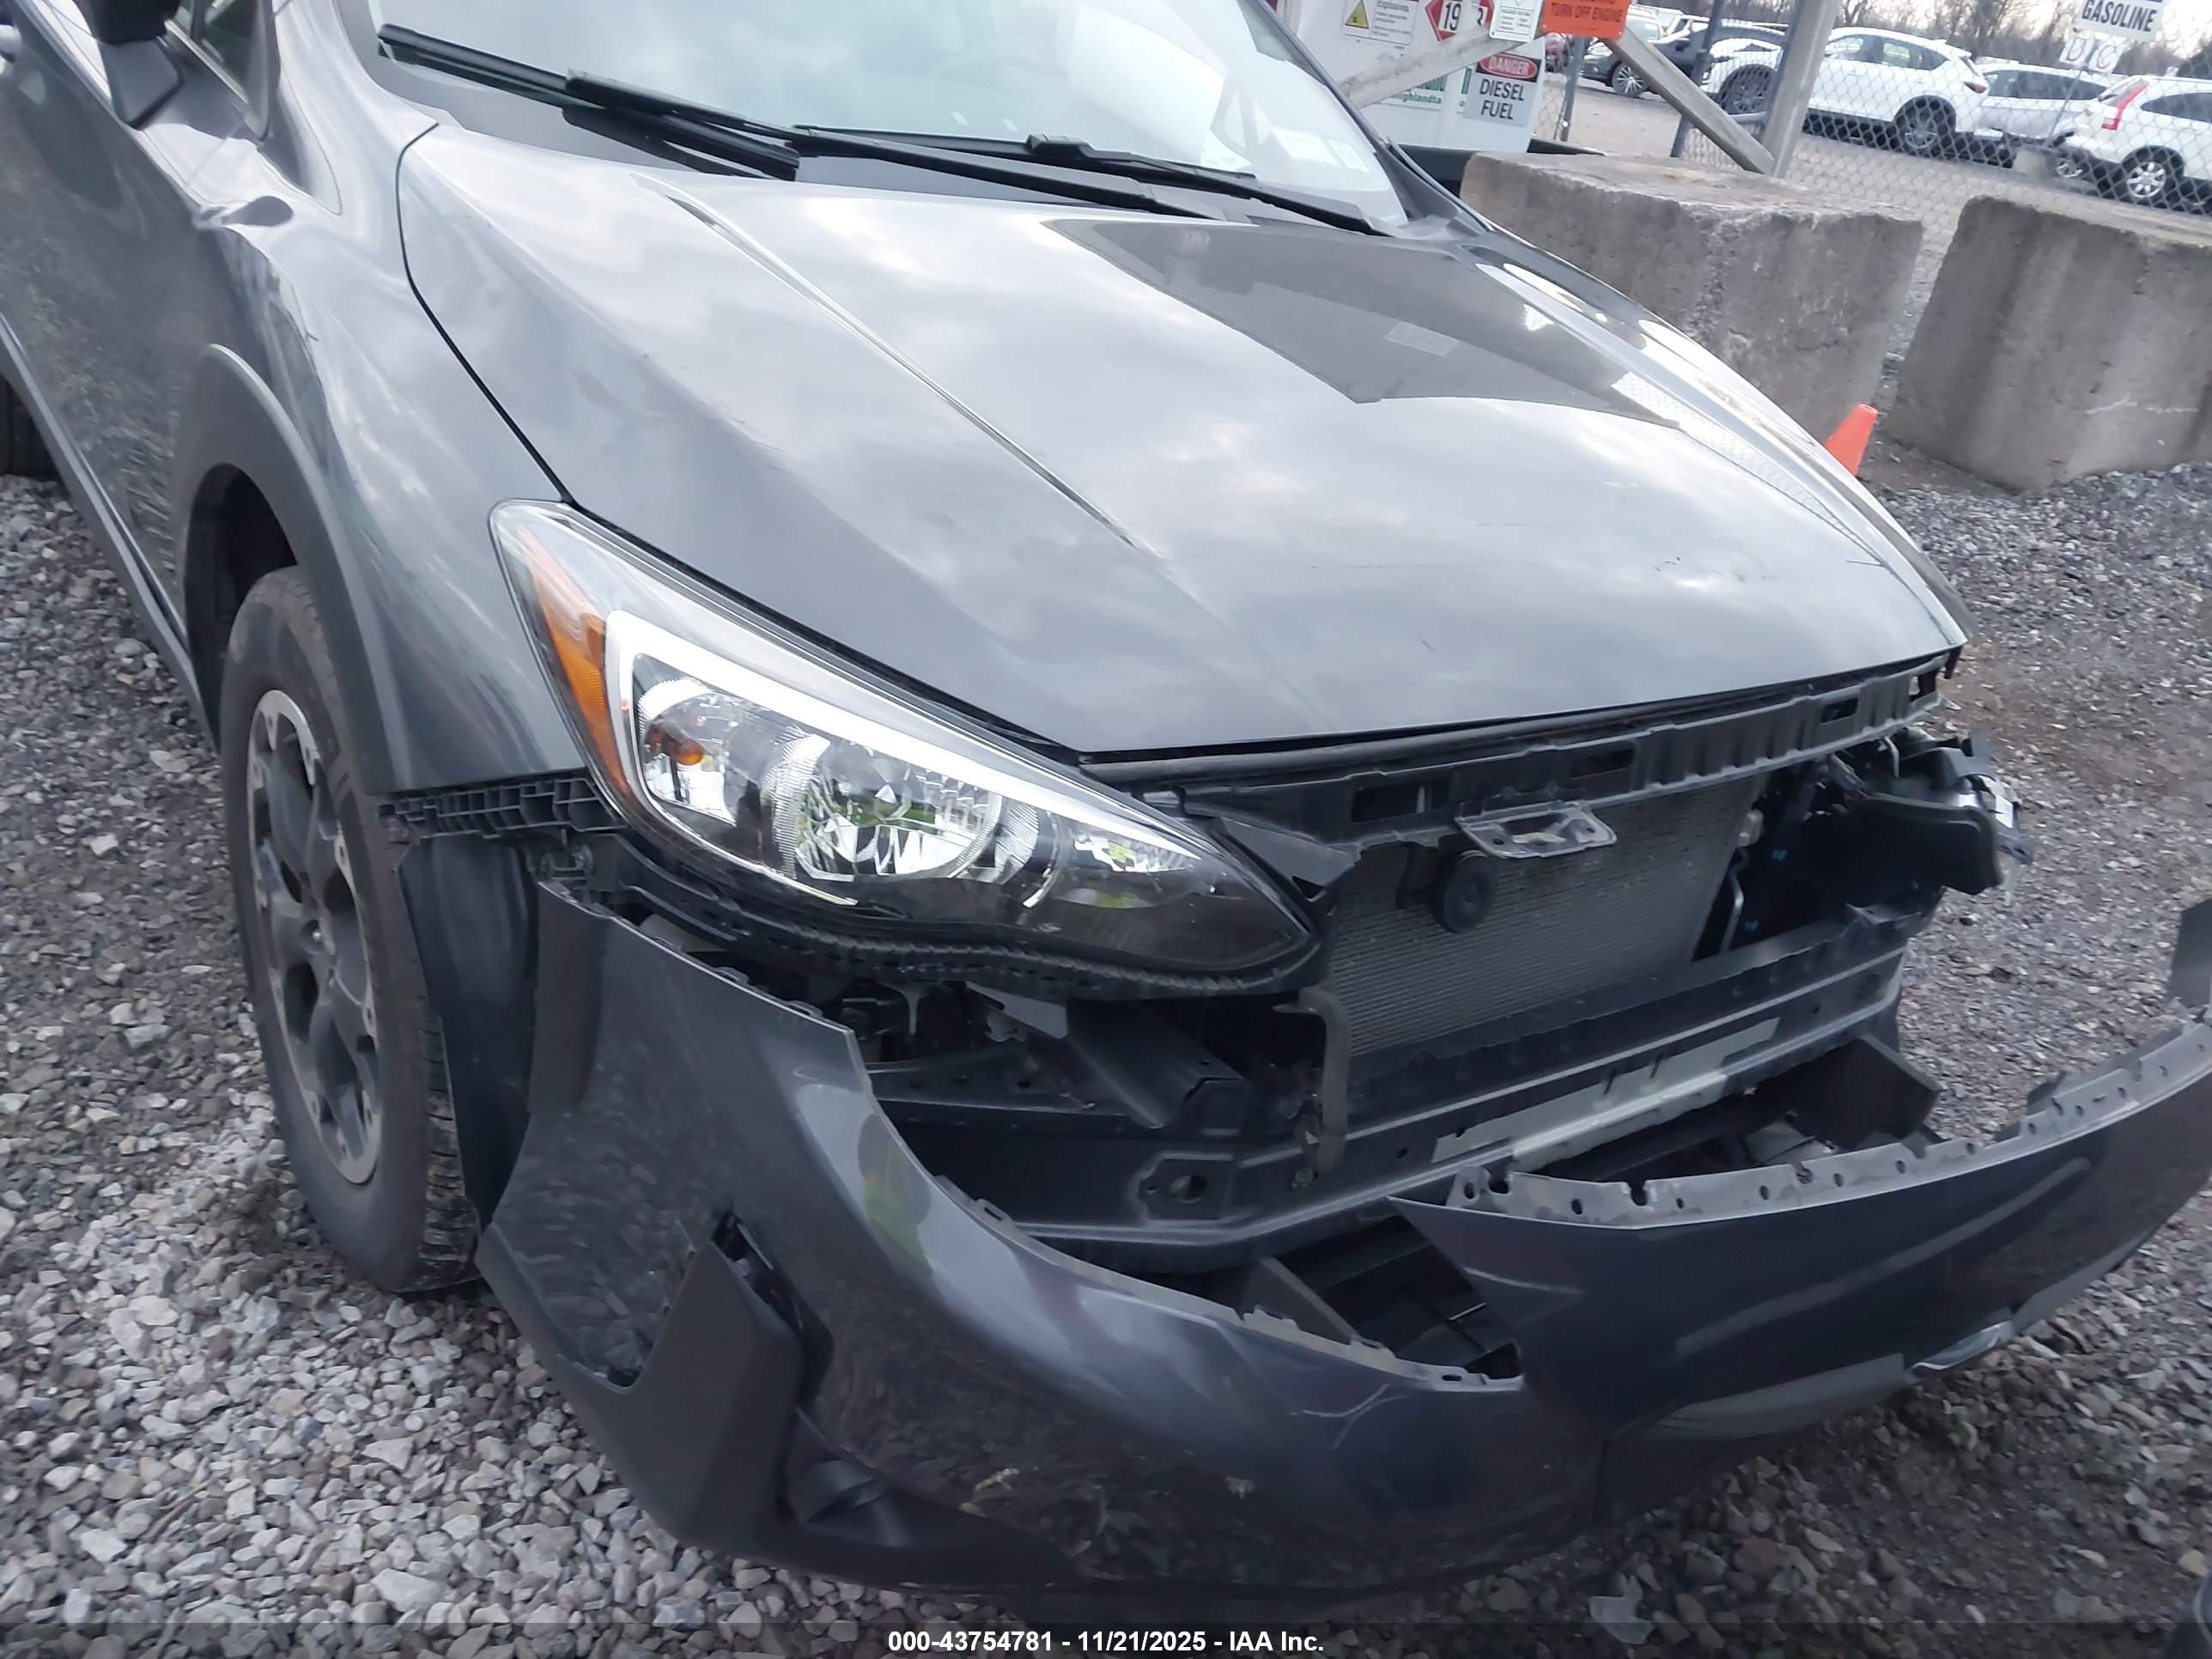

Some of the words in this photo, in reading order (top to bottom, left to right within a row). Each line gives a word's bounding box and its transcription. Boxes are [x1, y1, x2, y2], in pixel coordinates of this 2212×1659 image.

[1574, 5, 1592, 18] OFF
[1592, 7, 1623, 22] ENGINE
[2081, 0, 2157, 33] GASOLINE
[1488, 55, 1530, 76] DANGER
[1480, 78, 1524, 101] DIESEL
[1480, 100, 1514, 120] FUEL
